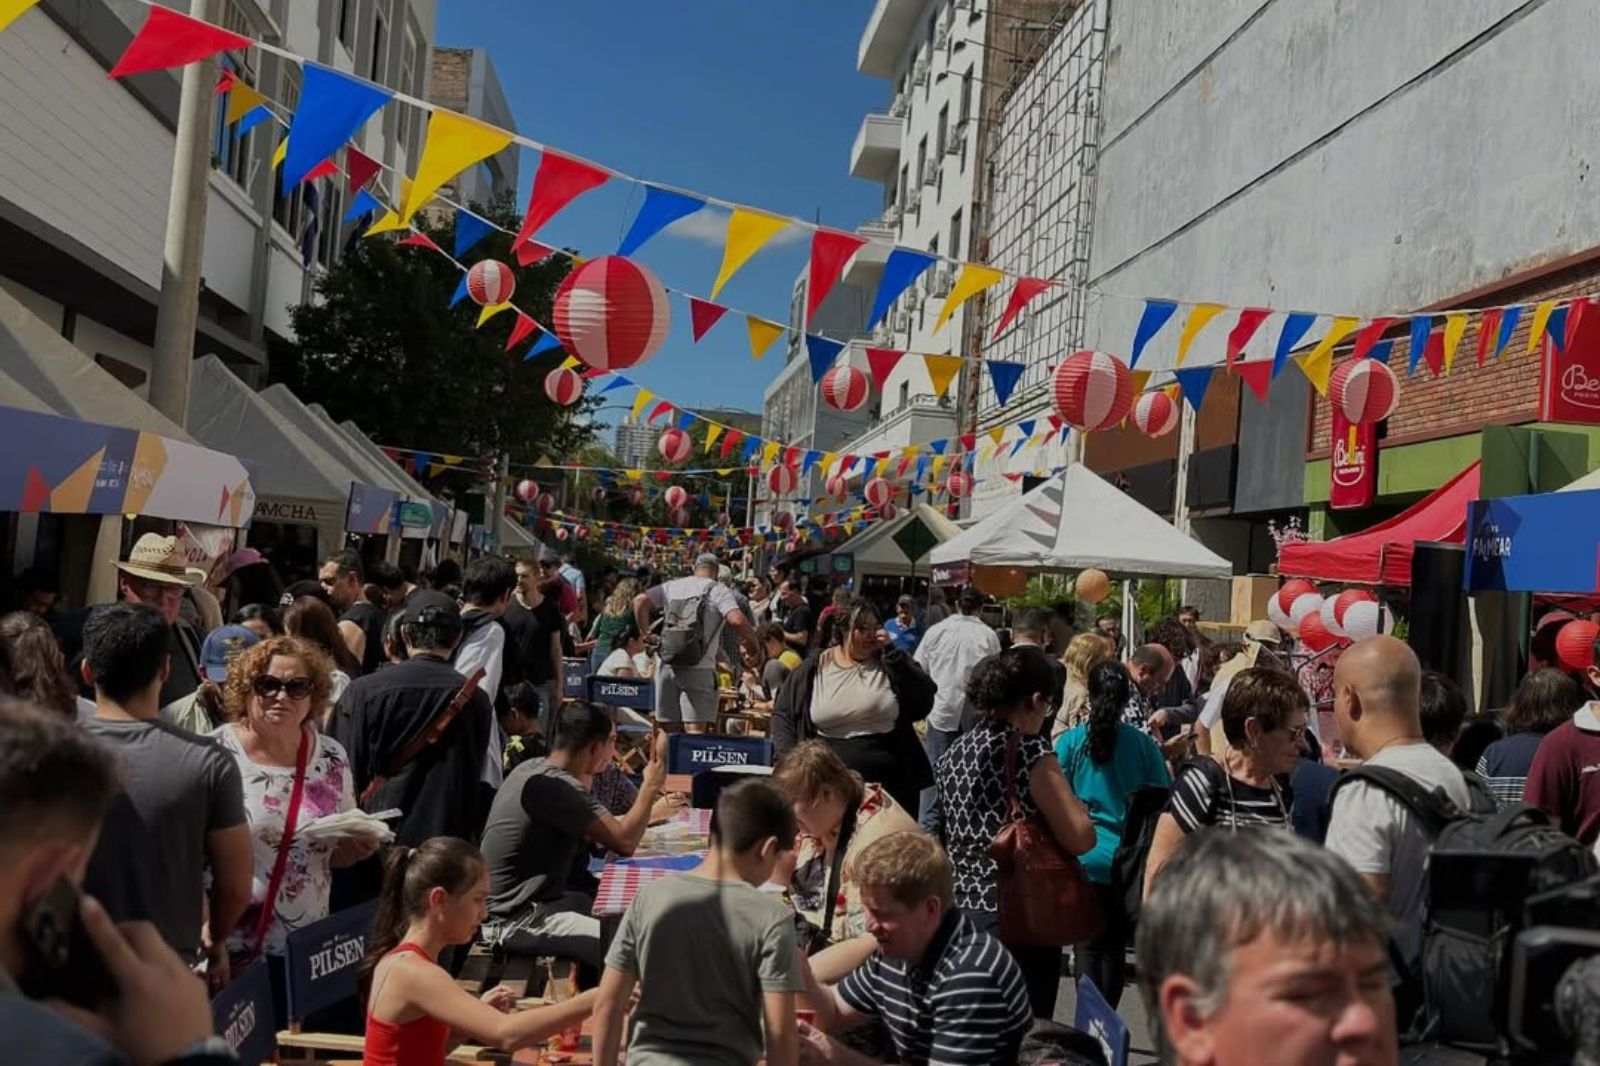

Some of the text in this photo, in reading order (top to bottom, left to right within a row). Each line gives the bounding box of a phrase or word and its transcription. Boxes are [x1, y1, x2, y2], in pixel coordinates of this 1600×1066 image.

[1334, 439, 1366, 467] Beini
[601, 685, 639, 696] PILSEN
[691, 750, 748, 765] PILSEN
[310, 936, 364, 980] PILSEN
